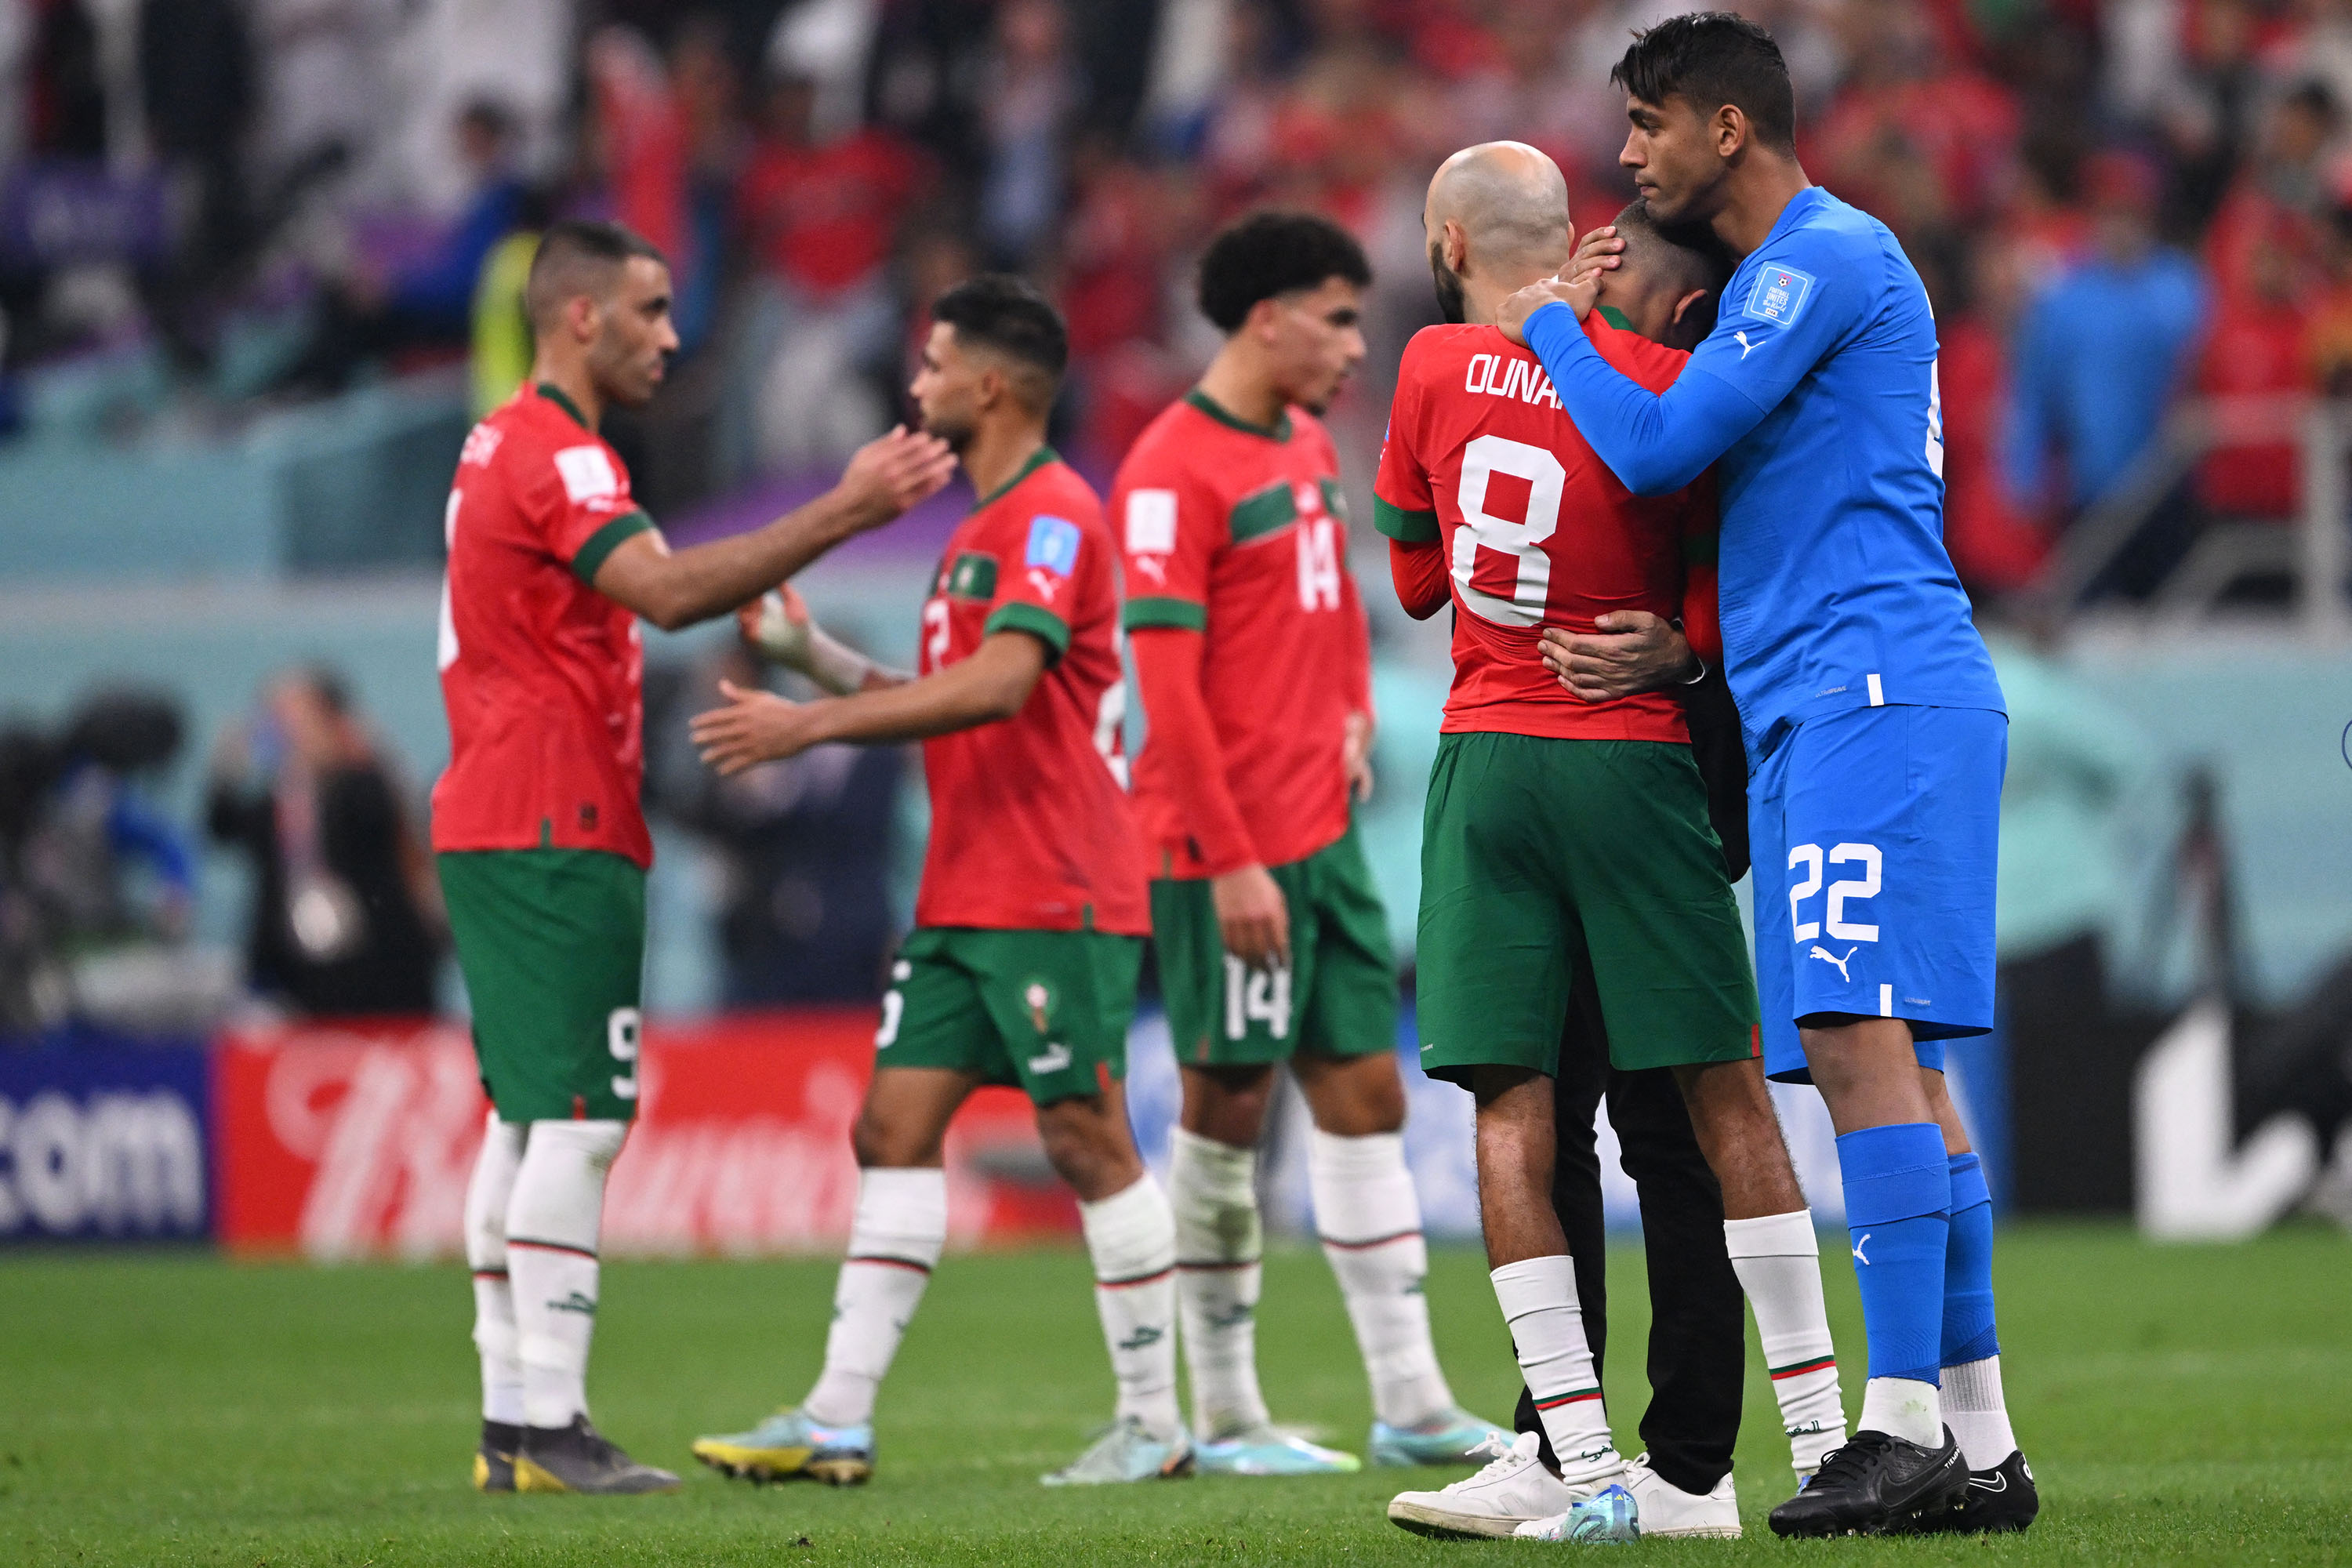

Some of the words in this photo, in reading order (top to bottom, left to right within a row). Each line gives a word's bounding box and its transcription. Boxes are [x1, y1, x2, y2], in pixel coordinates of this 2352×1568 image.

[1766, 292, 1788, 306] UNITES
[1768, 286, 1790, 298] FOOTBALL
[1465, 354, 1563, 410] OUNA
[1450, 434, 1566, 627] 8
[1788, 843, 1882, 944] 22
[1225, 951, 1292, 1040] 14
[608, 1008, 640, 1099] 9
